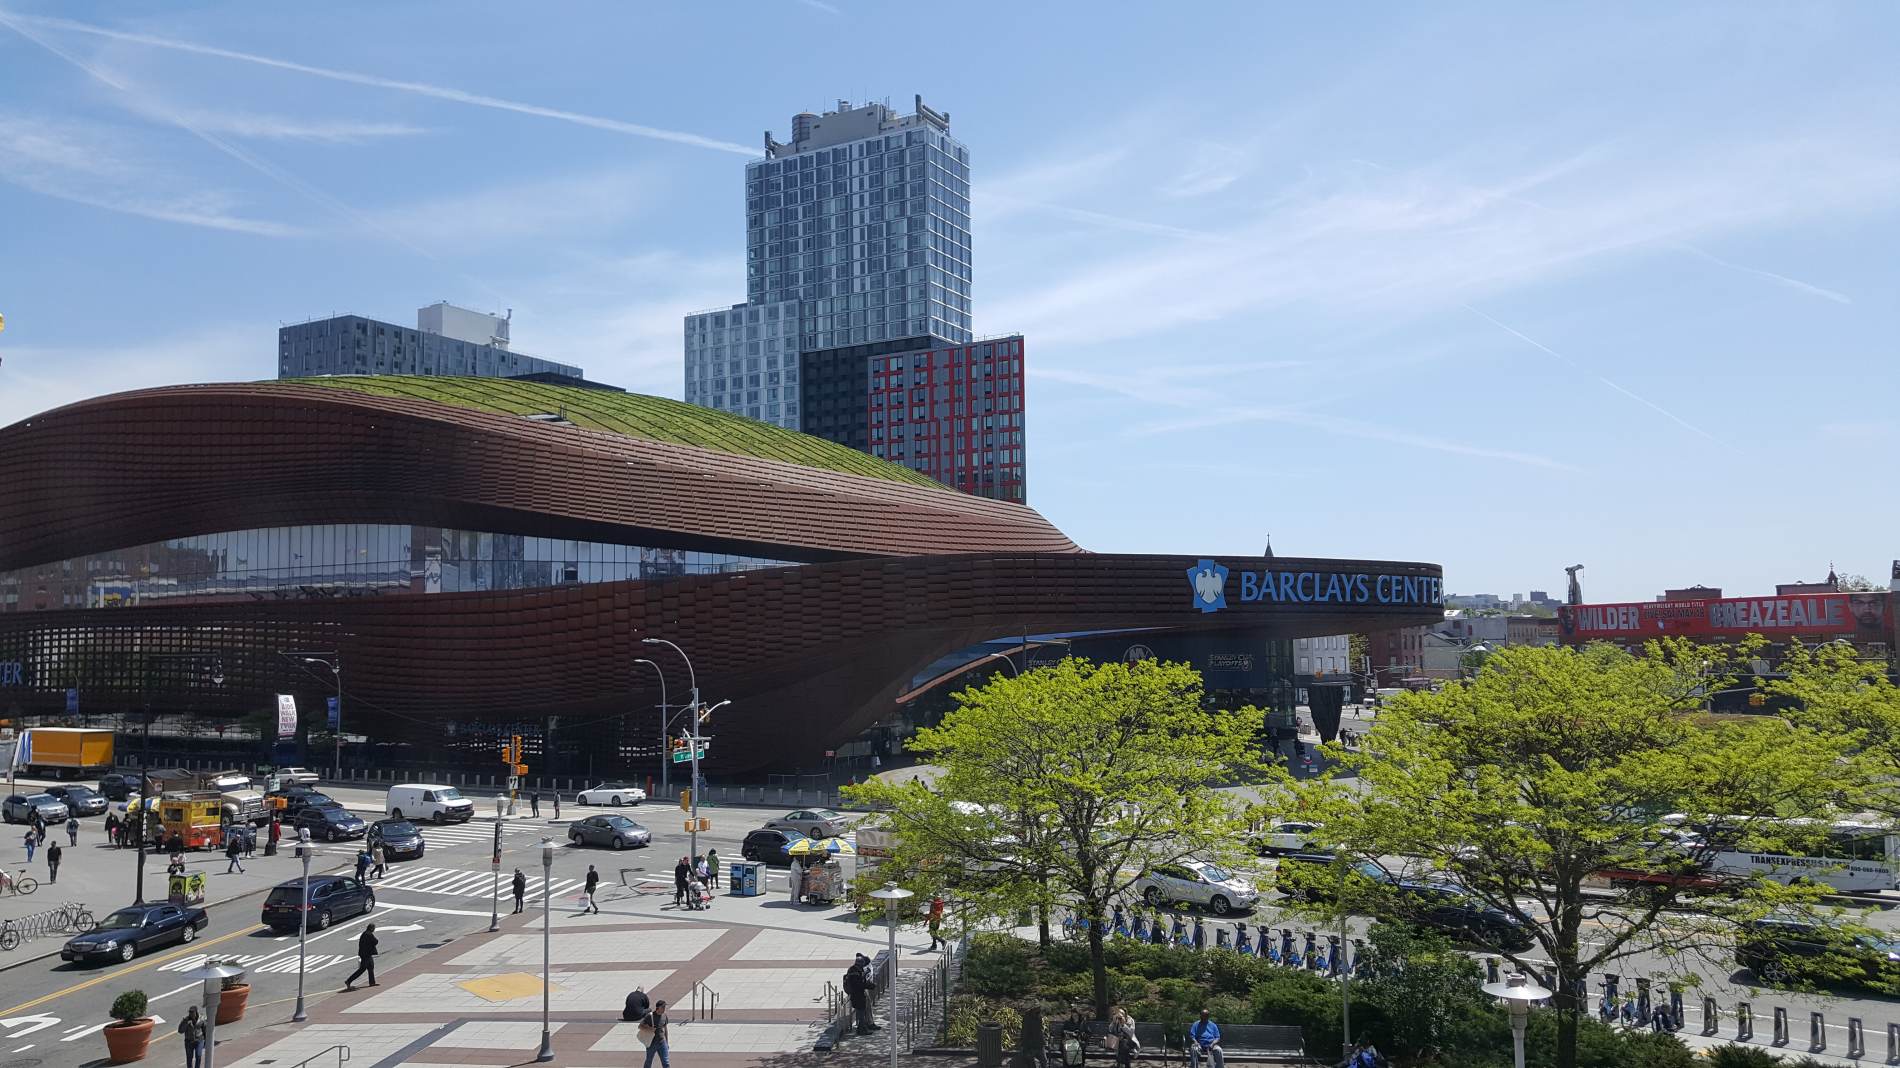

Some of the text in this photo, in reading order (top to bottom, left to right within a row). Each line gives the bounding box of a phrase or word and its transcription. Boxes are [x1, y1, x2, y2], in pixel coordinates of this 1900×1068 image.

[1241, 571, 1369, 603] BARCLAYS
[1578, 607, 1640, 630] WILDER
[1710, 598, 1846, 628] BREAZEALE
